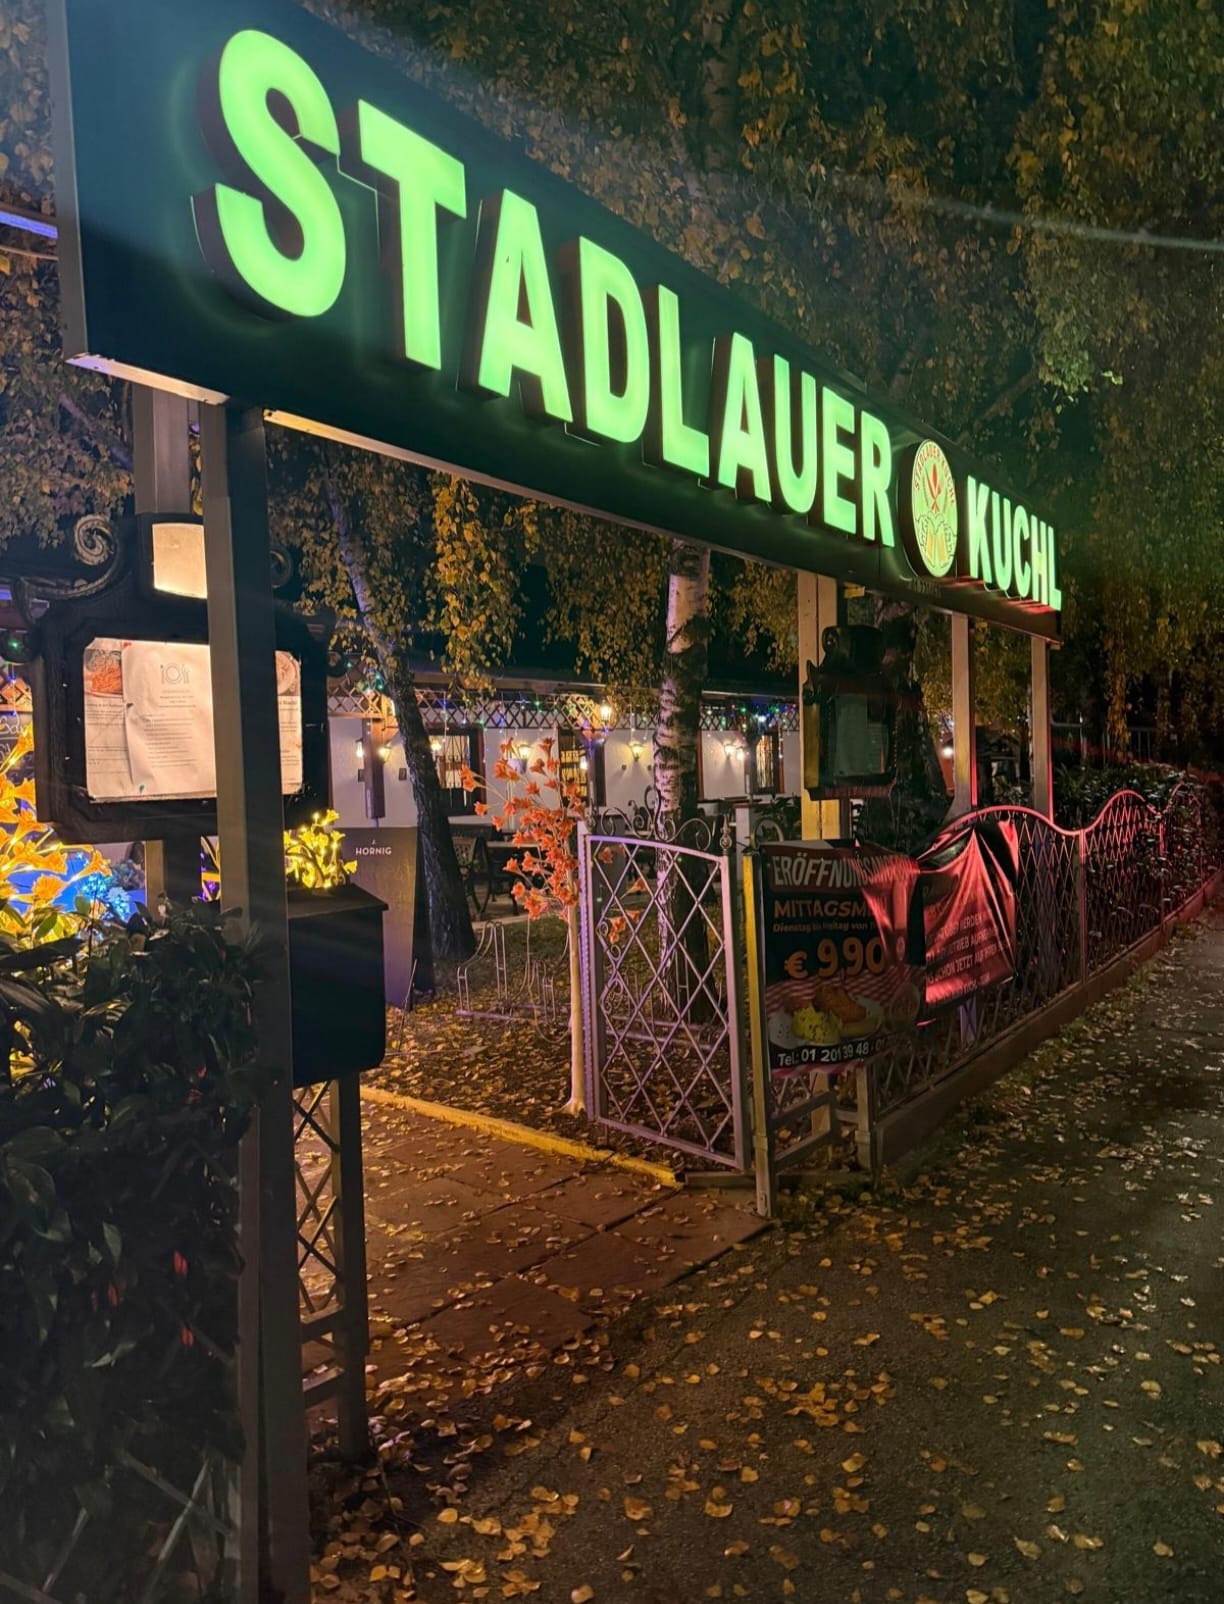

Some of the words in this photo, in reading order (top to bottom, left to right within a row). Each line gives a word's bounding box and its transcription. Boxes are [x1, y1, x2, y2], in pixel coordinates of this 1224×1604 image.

[216, 30, 895, 547] STADLAUER
[967, 475, 1062, 611] KUCHL
[355, 847, 392, 855] HORNIG
[773, 922, 811, 933] Dienstag
[784, 950, 808, 979] €
[801, 1049, 817, 1062] 01
[820, 1049, 841, 1062] 201
[842, 1044, 854, 1058] 39
[856, 1042, 869, 1055] 48
